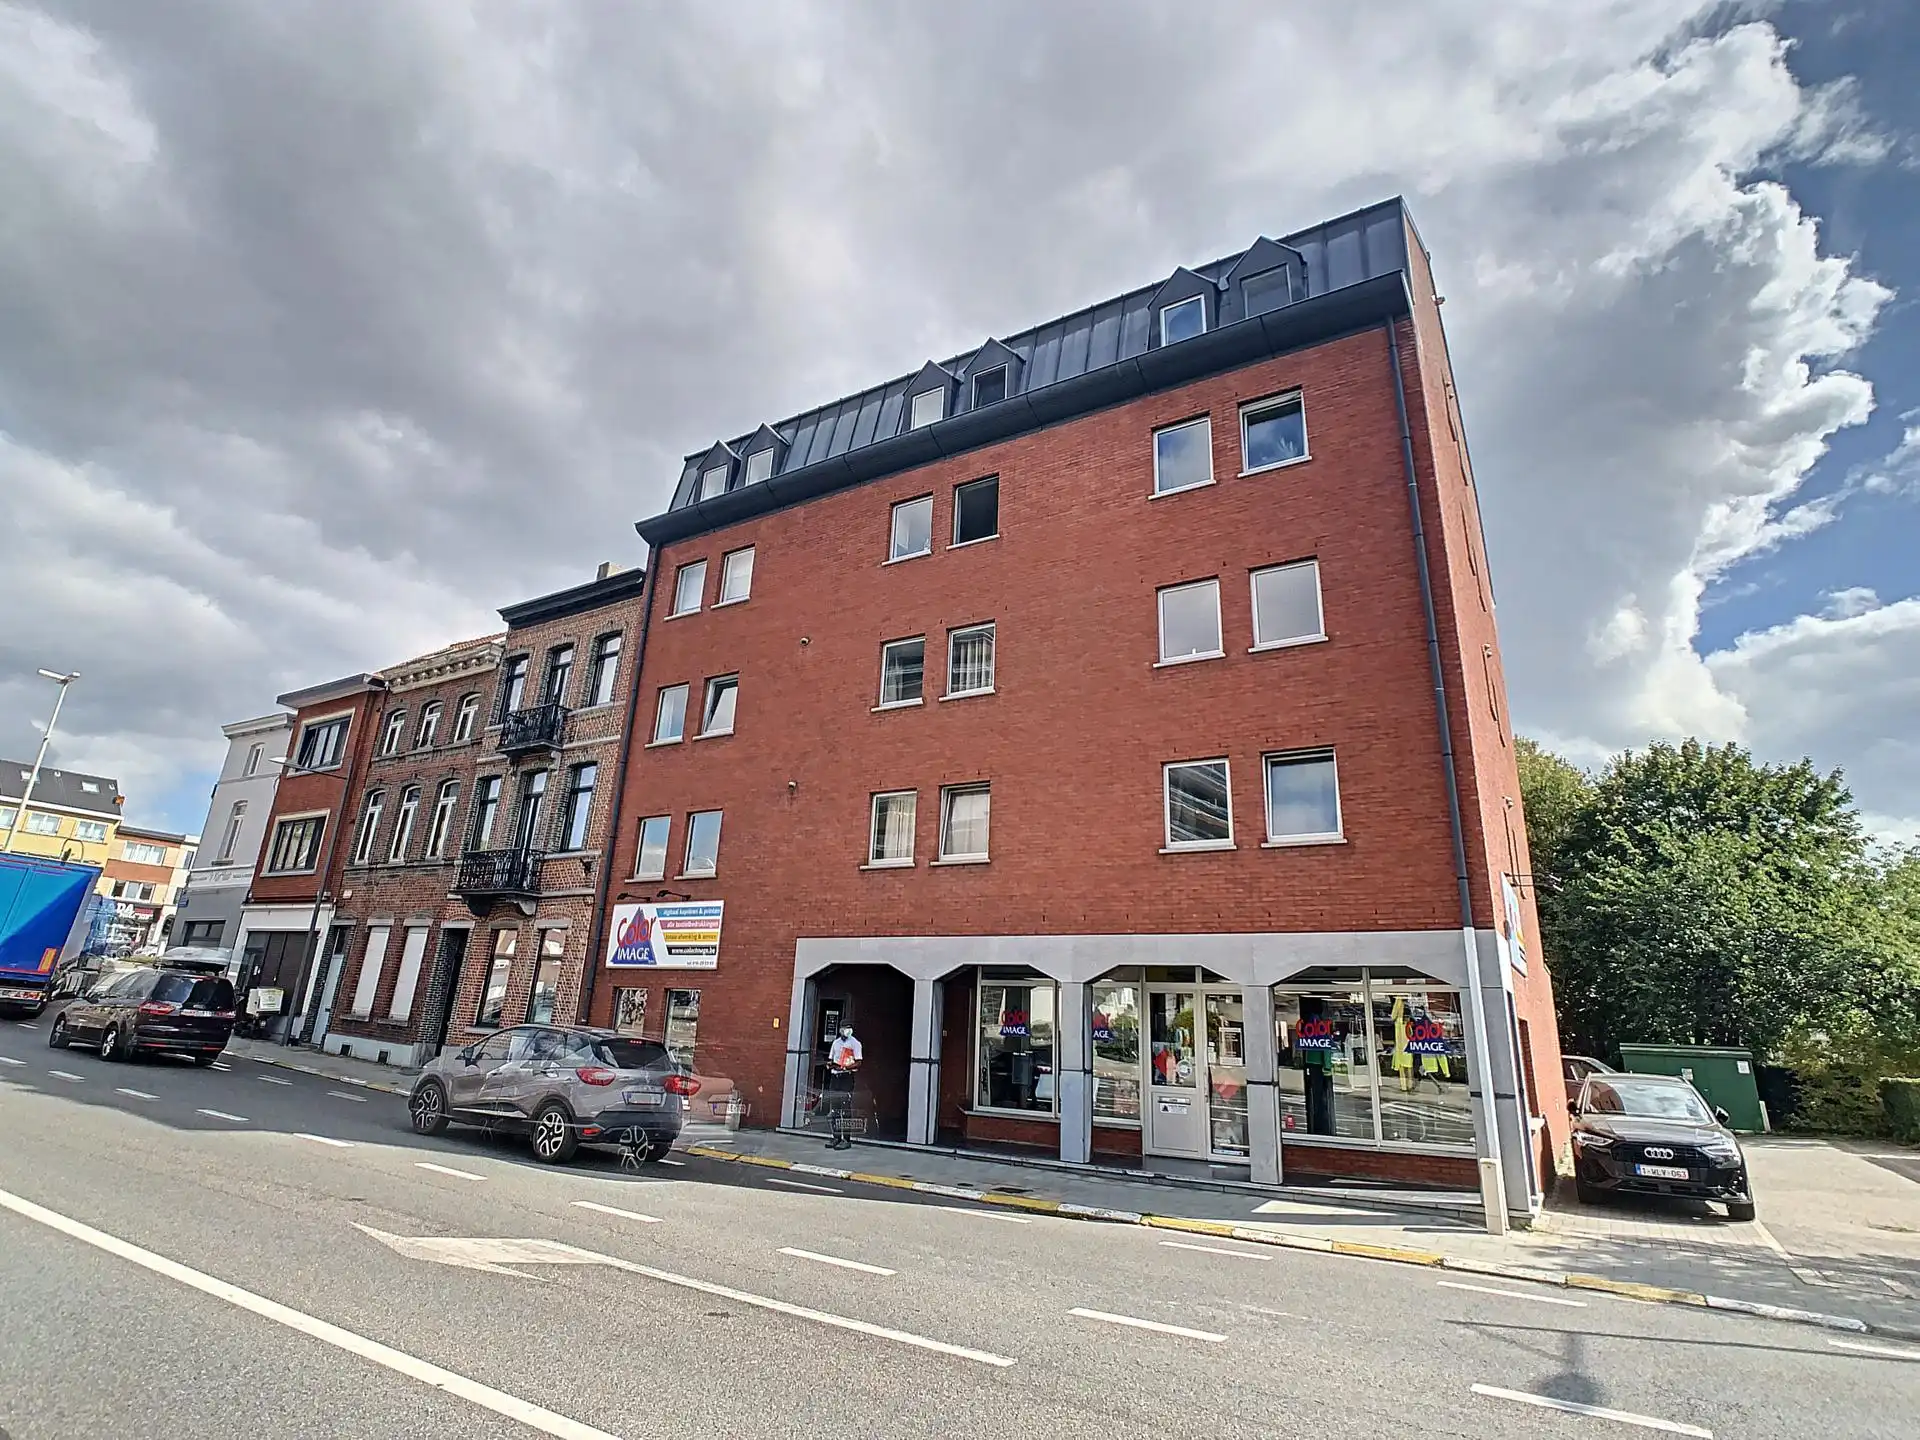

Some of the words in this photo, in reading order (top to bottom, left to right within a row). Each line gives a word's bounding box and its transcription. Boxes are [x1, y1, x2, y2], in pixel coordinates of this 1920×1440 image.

[617, 916, 656, 948] Color
[618, 947, 650, 960] IMAGE
[1003, 1026, 1026, 1034] IMAGE
[1296, 1017, 1333, 1038] Color
[1405, 1020, 1445, 1042] Color
[1093, 1030, 1109, 1038] AGE
[1299, 1037, 1332, 1049] IMAGE
[1409, 1040, 1445, 1052] IMAGE
